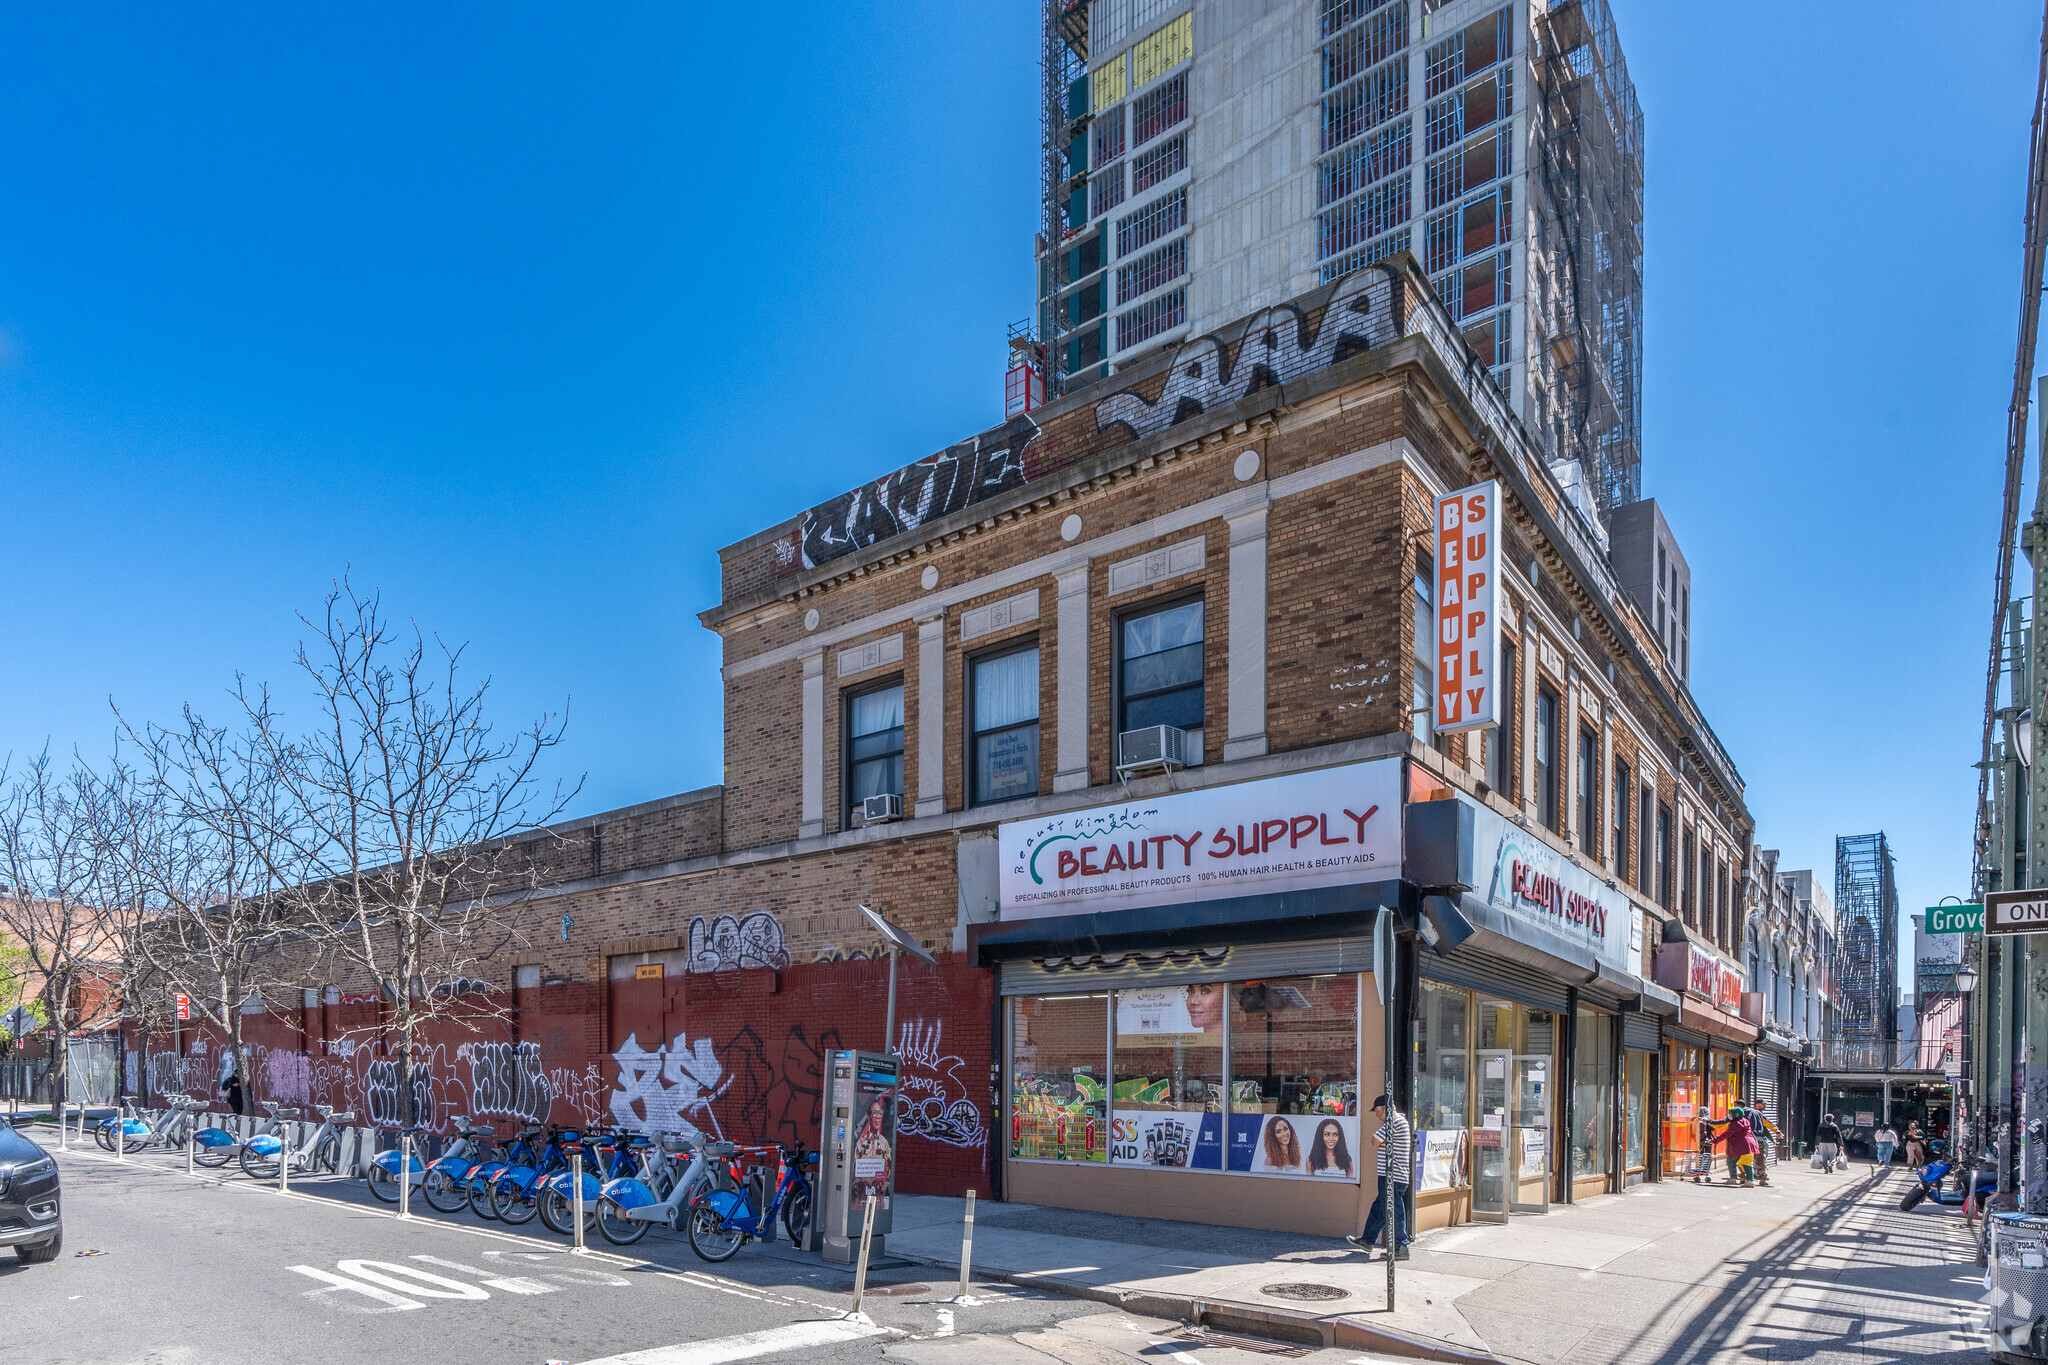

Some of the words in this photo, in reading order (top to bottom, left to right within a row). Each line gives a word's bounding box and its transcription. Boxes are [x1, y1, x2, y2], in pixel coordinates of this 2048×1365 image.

[1442, 502, 1460, 720] BEAUTY
[1466, 494, 1487, 715] SUPPLY
[1015, 890, 1058, 902] SPECIALIZING
[1059, 890, 1066, 898] IN
[1067, 884, 1119, 897] PROFESSIONAL
[1120, 879, 1149, 891] BEAUTY
[1150, 874, 1191, 887] PRODUCTS
[1198, 871, 1217, 881] 100%
[1219, 867, 1248, 879] HUMAN
[1250, 865, 1270, 876] HAIR
[1272, 861, 1305, 873] HEALTH
[1307, 859, 1313, 869] &
[1315, 855, 1352, 867] BEAUTY
[1352, 853, 1375, 864] AIDS
[1058, 830, 1203, 879] BEAUTY
[1208, 804, 1379, 859] SUPPLY
[1512, 859, 1566, 918] BEAUTY
[1566, 890, 1608, 938] SUPPLY
[611, 1188, 621, 1196] citi
[2019, 1221, 2041, 1229] Don't
